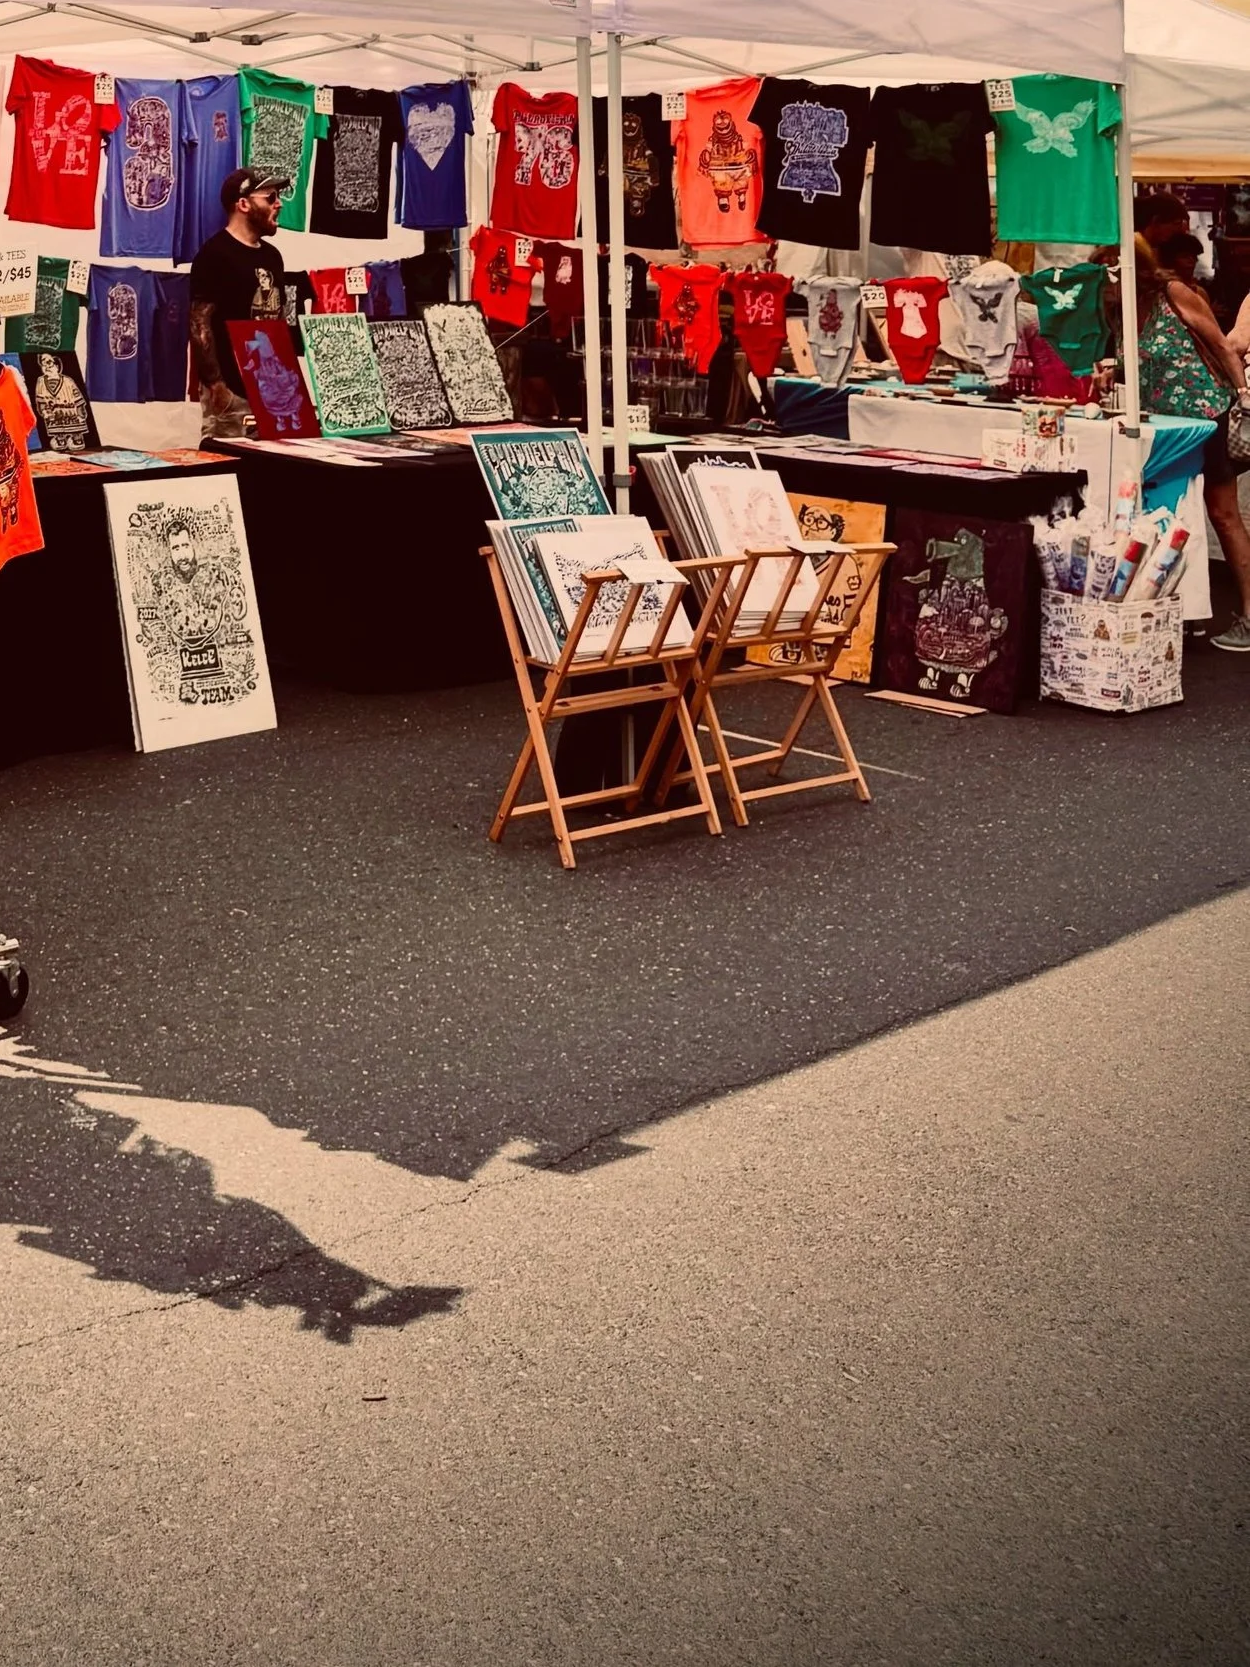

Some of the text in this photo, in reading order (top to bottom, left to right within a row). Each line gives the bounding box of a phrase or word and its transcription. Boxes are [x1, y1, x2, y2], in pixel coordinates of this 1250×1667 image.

[990, 91, 1012, 99] $25
[6, 250, 26, 260] TEES
[71, 271, 87, 280] $25
[862, 292, 885, 301] $20
[201, 686, 235, 705] TEAM
